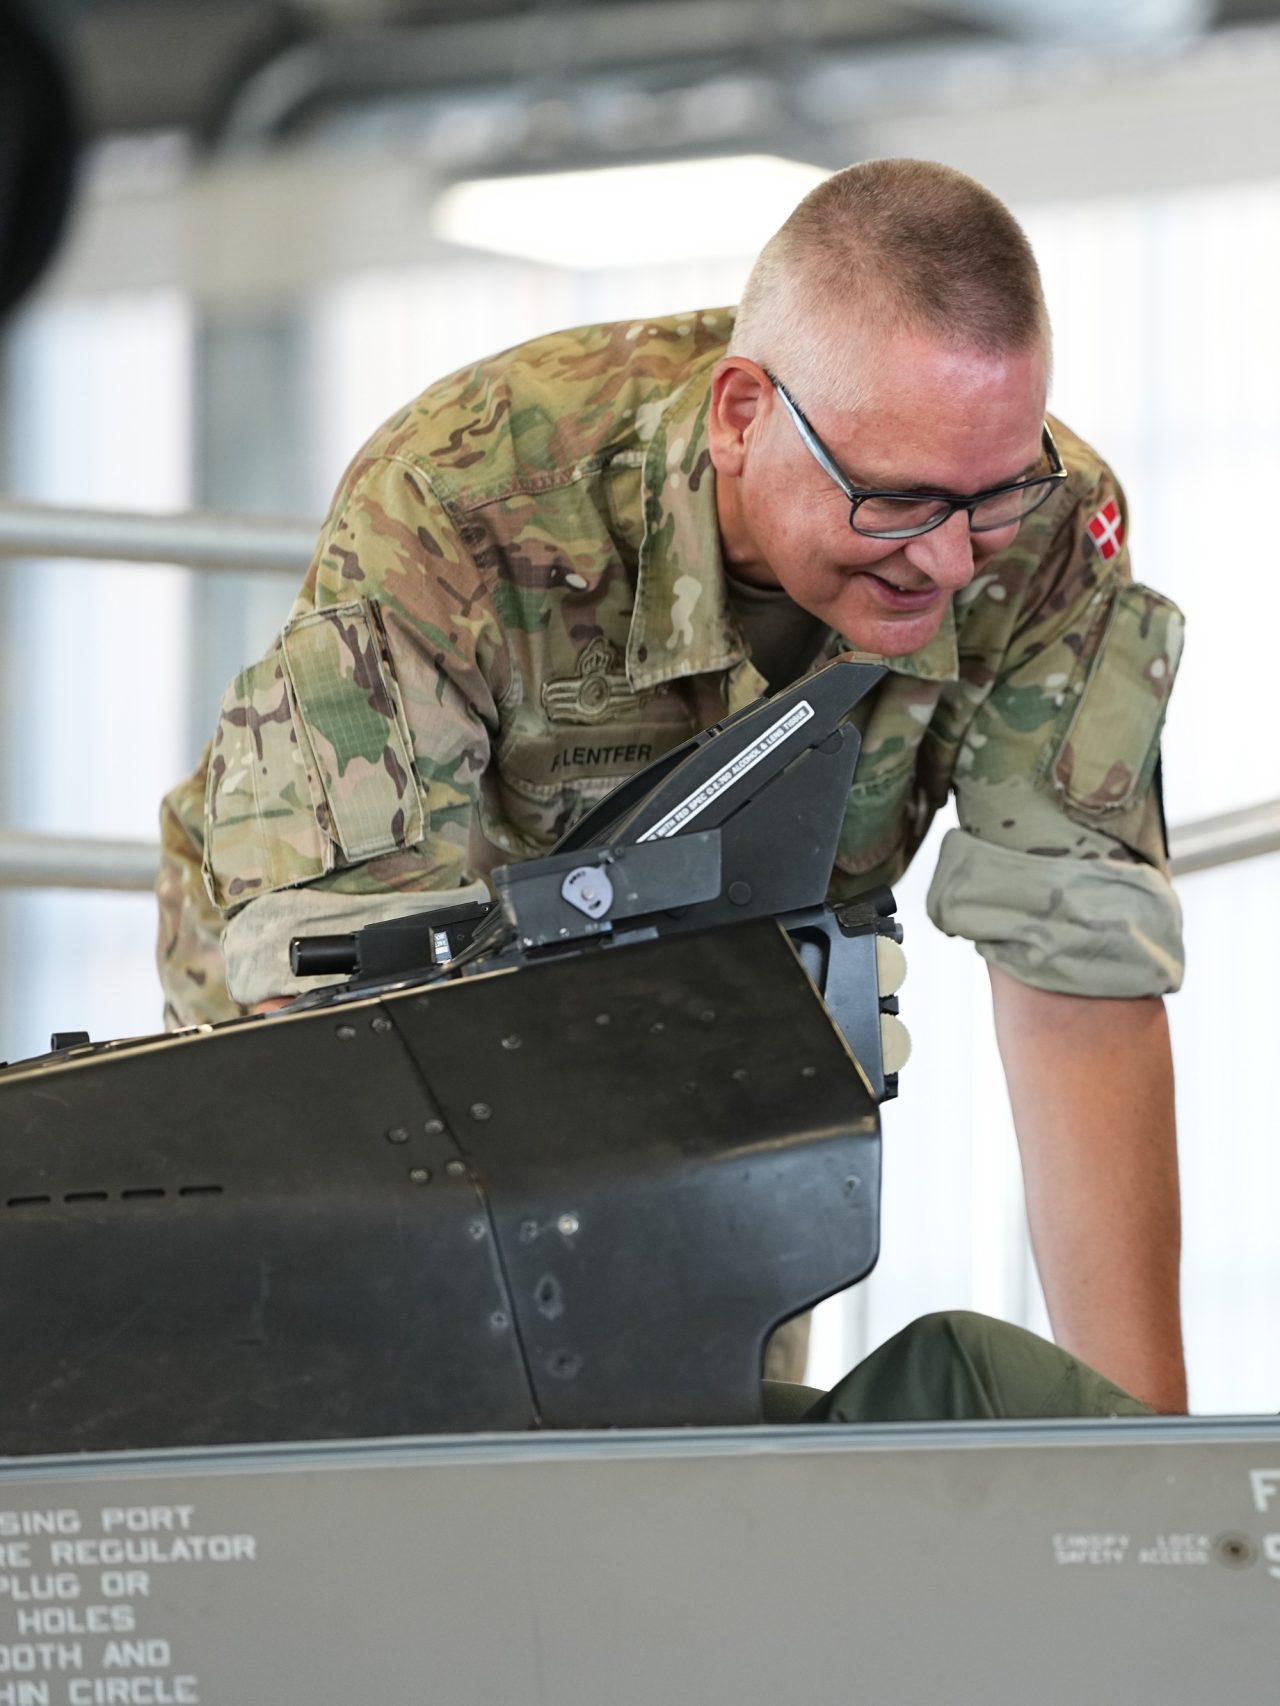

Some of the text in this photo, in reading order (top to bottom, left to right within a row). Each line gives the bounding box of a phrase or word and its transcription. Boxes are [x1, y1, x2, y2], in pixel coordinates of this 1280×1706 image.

[731, 747, 762, 775] ALCOHOL
[765, 727, 785, 746] LENS
[0, 1504, 194, 1536] SING PORT
[0, 1534, 256, 1569] E REGULATOR
[101, 1570, 150, 1597] OR
[17, 1604, 136, 1635] HOLES
[102, 1638, 171, 1670] AND
[69, 1675, 198, 1706] CIRCLE
